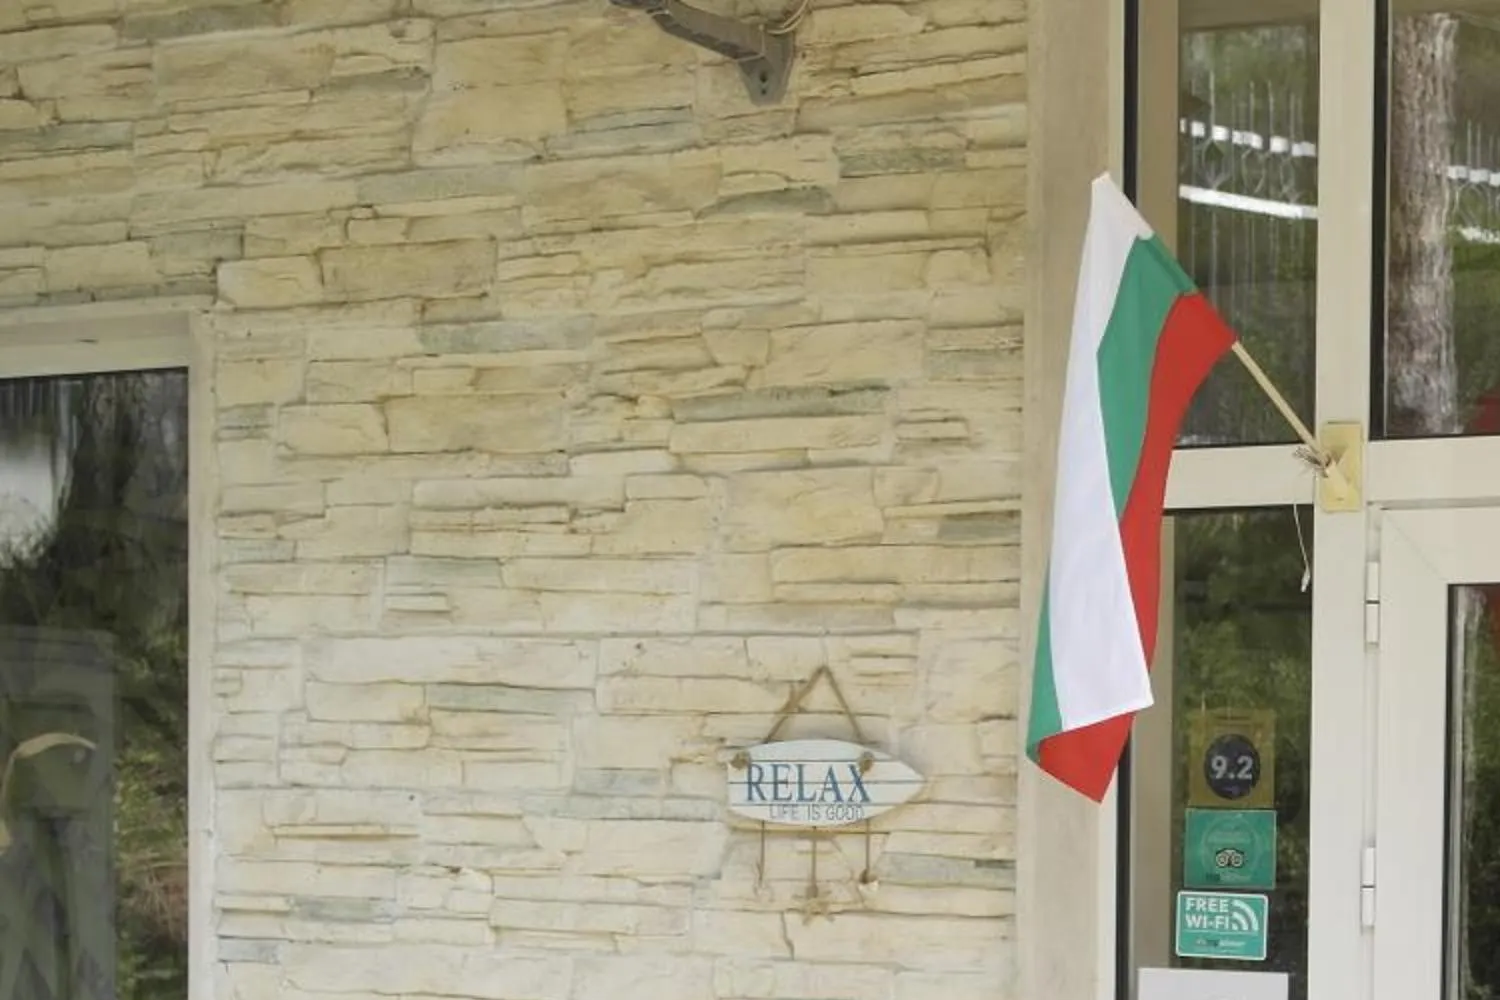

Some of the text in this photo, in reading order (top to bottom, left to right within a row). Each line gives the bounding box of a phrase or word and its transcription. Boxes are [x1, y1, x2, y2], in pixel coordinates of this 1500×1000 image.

[1210, 756, 1254, 780] 9.2
[746, 763, 871, 803] RELAX
[769, 804, 864, 821] LIFE IS GOOD
[1185, 897, 1229, 913] FREE
[1185, 914, 1230, 930] WI-FI
